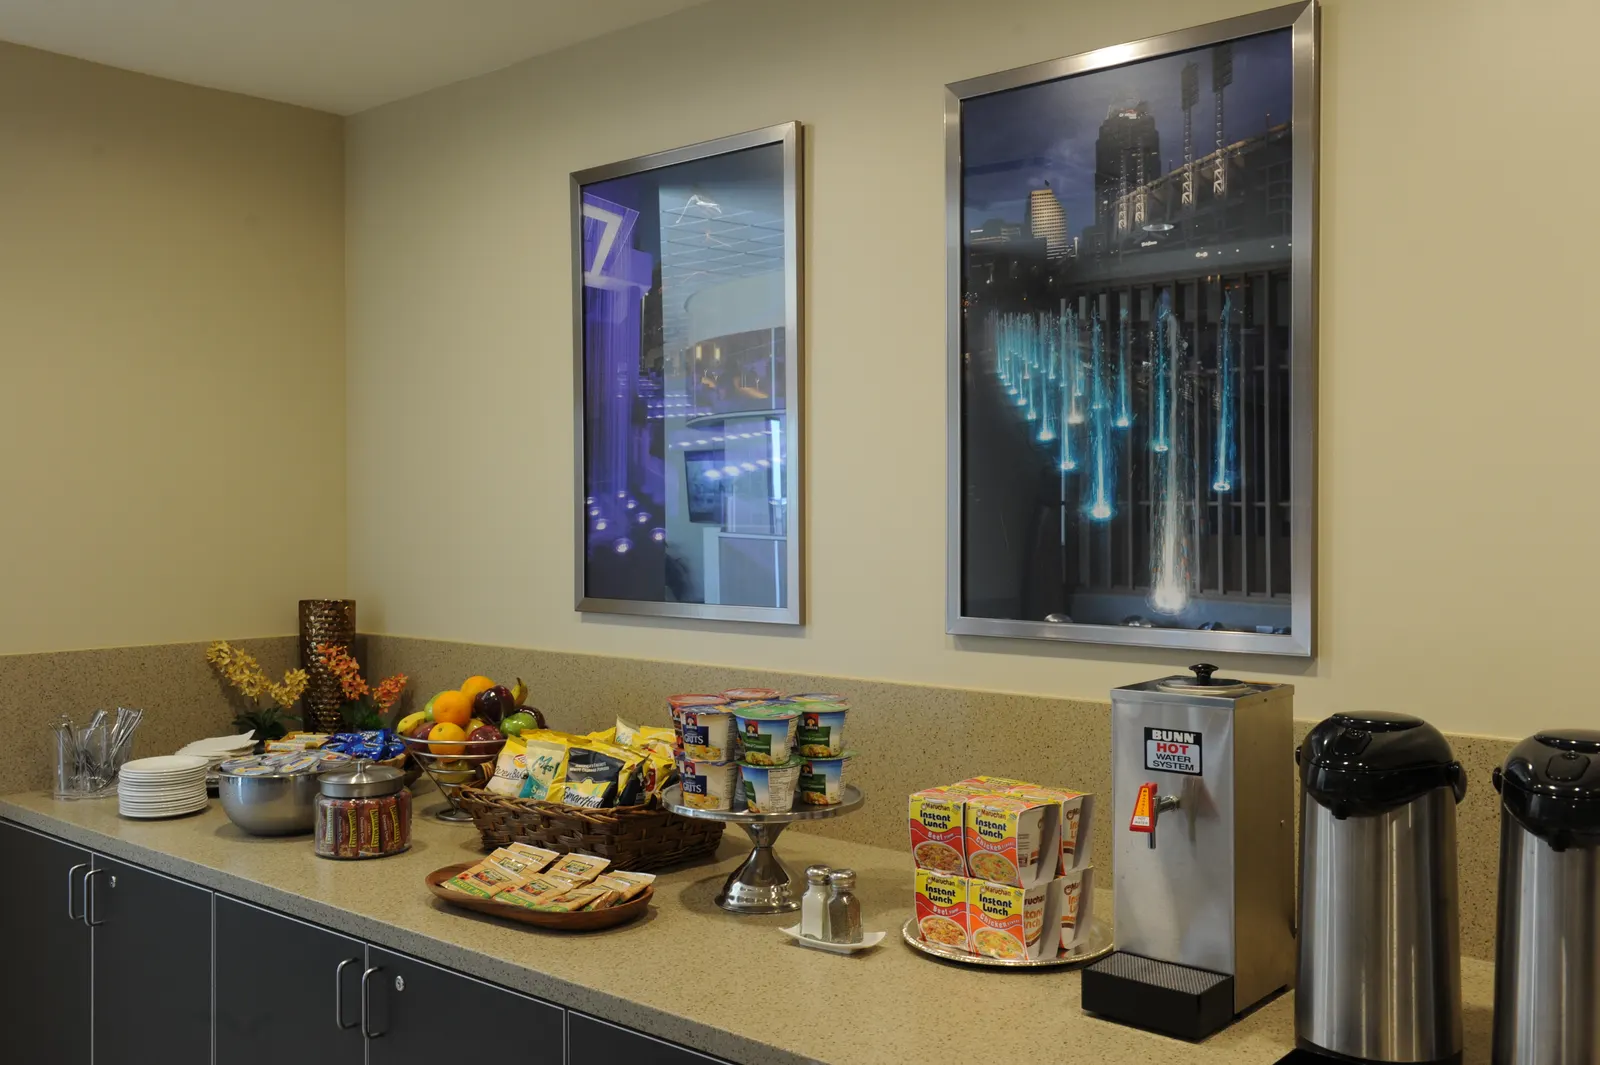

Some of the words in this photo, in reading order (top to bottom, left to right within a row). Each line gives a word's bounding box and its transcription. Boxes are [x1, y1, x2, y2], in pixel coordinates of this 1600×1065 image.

[1152, 730, 1194, 744] BUNN
[1156, 742, 1189, 755] HOT
[1156, 753, 1191, 763] WATER
[1153, 760, 1194, 771] SYSTEM
[925, 802, 950, 812] Maruchan
[920, 810, 950, 822] Instant
[981, 809, 1006, 820] Maruchan
[924, 819, 948, 830] Lunch
[976, 817, 1006, 832] Instant
[978, 827, 1003, 840] Lunch
[976, 837, 1002, 850] Chicken
[931, 877, 956, 886] Maruchan
[926, 884, 956, 897] Instant
[984, 886, 1012, 896] Maruchan
[928, 893, 952, 904] Lunch
[979, 894, 1012, 909] Instant
[982, 904, 1008, 916] Lunch
[980, 914, 1006, 928] Chicken
